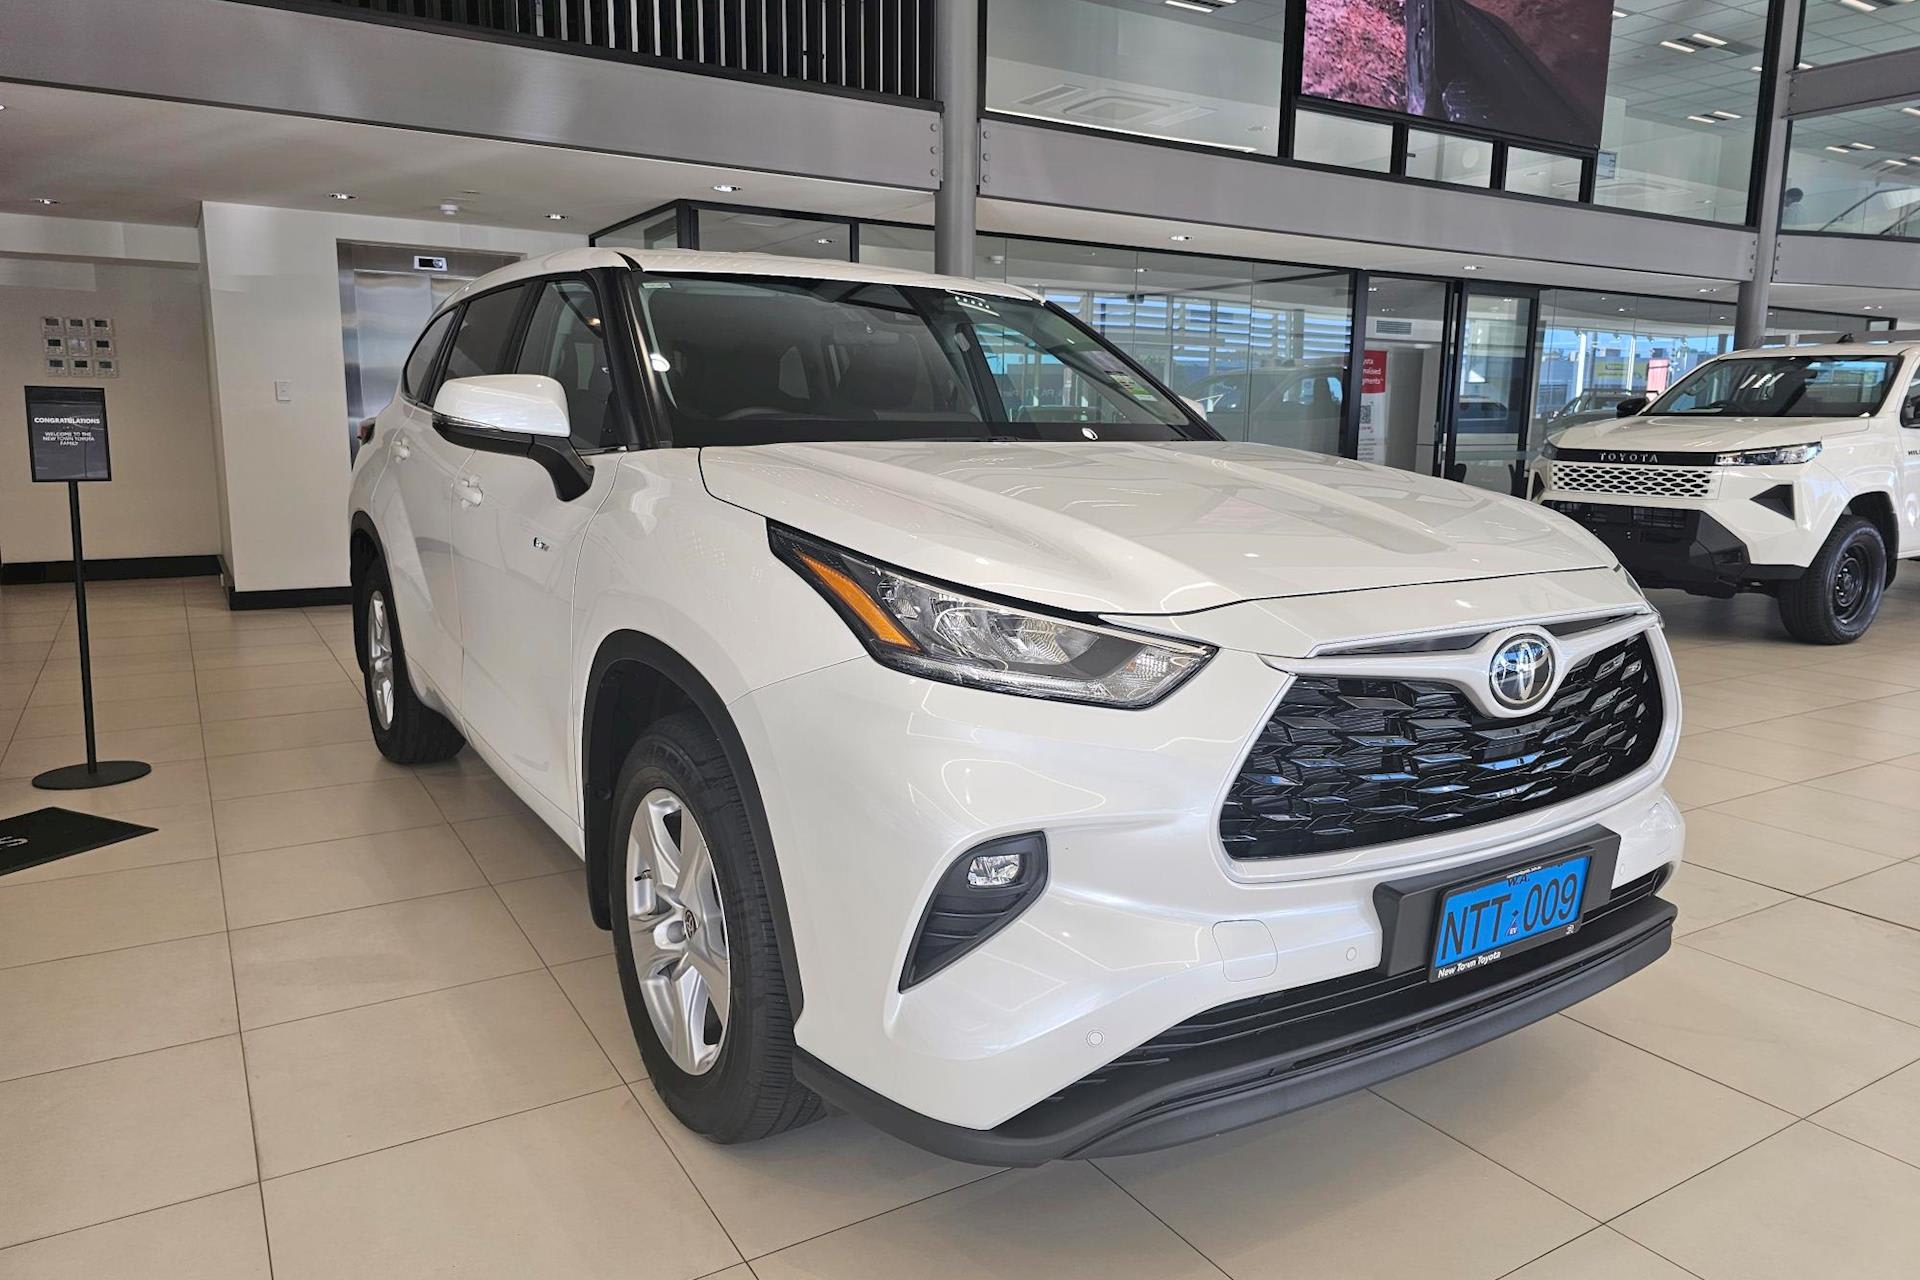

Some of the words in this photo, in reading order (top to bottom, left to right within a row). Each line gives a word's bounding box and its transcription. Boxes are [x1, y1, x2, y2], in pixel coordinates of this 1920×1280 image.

[1600, 452, 1658, 463] TOYOTA
[1441, 893, 1512, 961] NTT
[1523, 872, 1578, 932] 009
[1437, 967, 1456, 979] New
[1457, 959, 1477, 972] Town
[1477, 951, 1502, 965] Toyota
